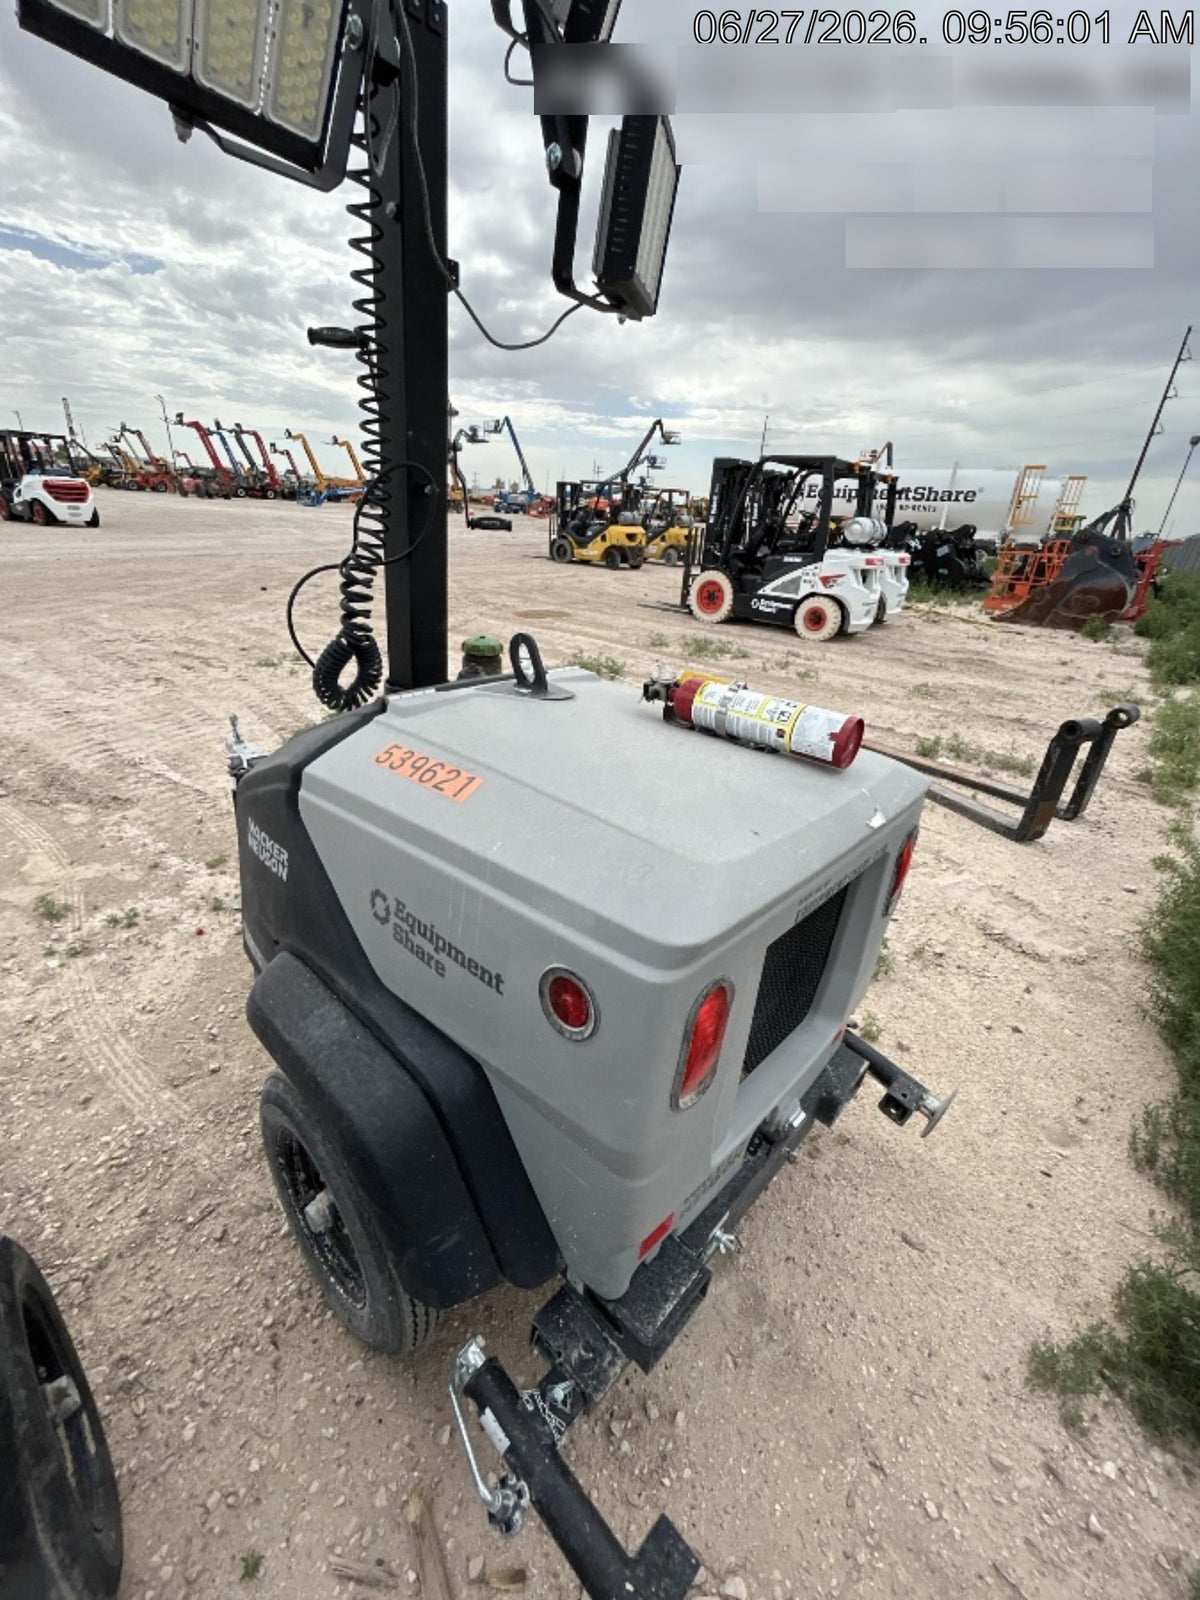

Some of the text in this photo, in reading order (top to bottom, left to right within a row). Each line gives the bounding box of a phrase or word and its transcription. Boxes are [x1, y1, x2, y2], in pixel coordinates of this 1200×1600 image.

[374, 744, 477, 798] 539621
[248, 816, 289, 867] WACKER
[392, 921, 447, 978] Share
[393, 897, 506, 996] Equipment
